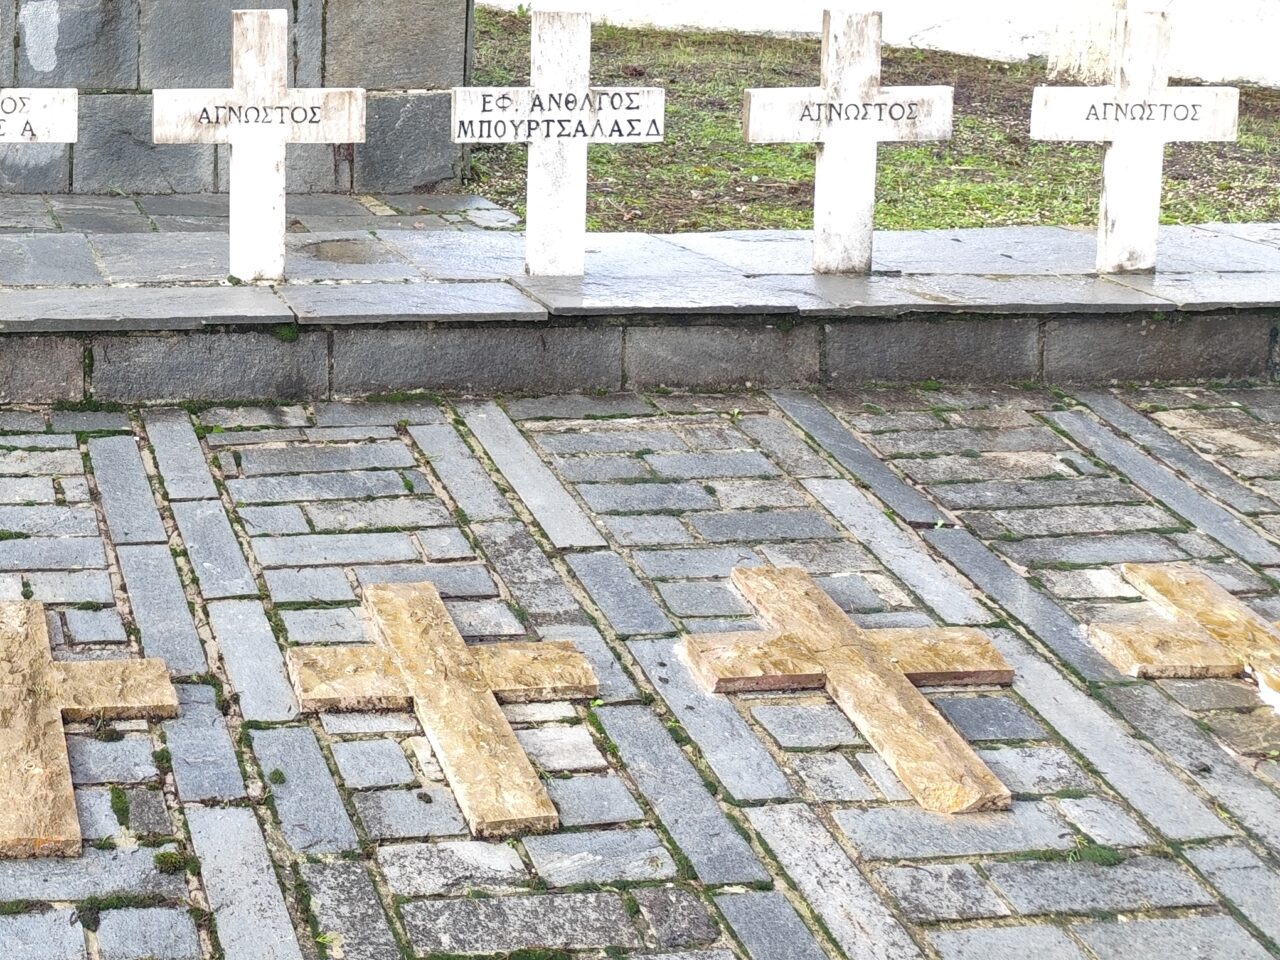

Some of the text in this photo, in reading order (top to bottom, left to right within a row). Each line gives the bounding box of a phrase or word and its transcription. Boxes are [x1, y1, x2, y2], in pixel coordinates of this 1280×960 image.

[480, 90, 642, 114] ΕΦ. ΑΝΘΛΓΟΣ
[798, 99, 921, 124] ΑΓΝΩΣΤΟΣ
[1084, 102, 1202, 122] ΑΓΝΩΣΤΟΣ
[196, 103, 323, 127] ΑΓΝΩΣΤΟΣ
[20, 120, 38, 140] Α
[455, 118, 664, 142] ΜΠΟΥΡΤΣΑΛΑΣ Δ
